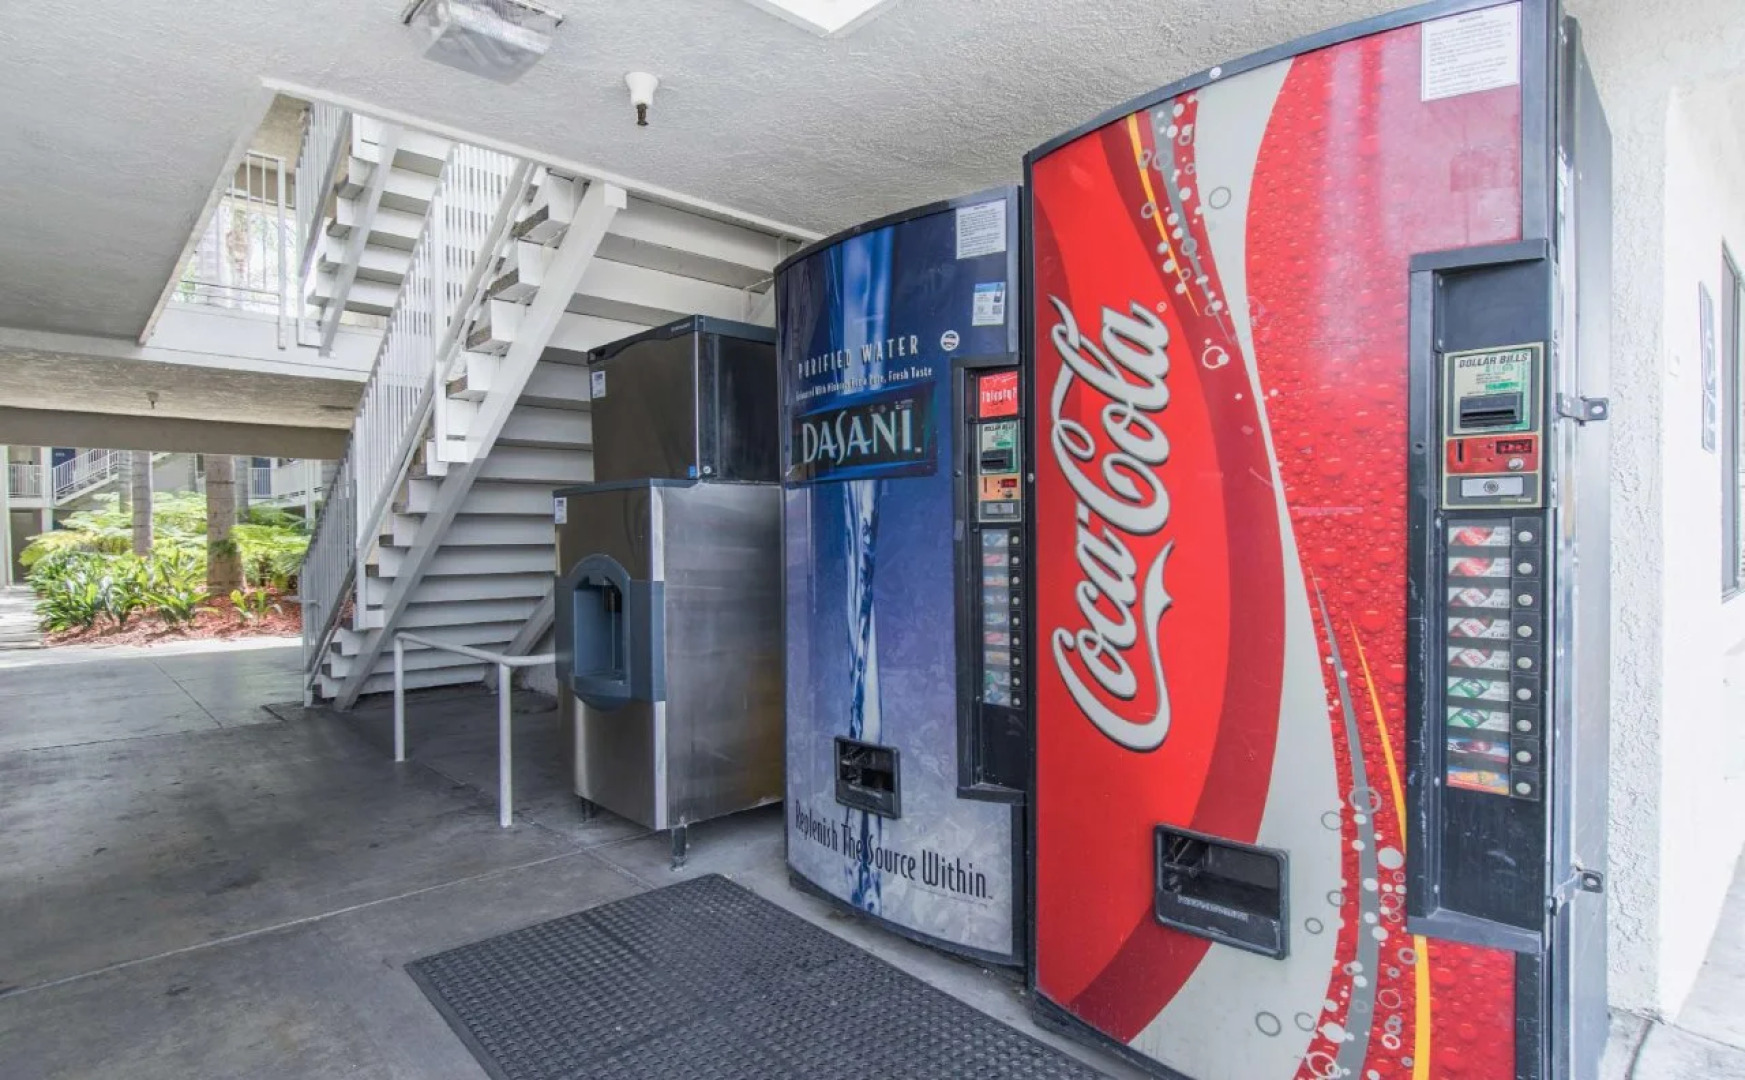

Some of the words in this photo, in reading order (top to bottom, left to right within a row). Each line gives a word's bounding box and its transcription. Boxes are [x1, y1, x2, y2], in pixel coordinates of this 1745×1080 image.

[798, 349, 851, 379] PURIFIED
[861, 335, 918, 365] WATER
[889, 367, 909, 381] Fresh
[911, 365, 932, 379] Taste
[1459, 356, 1498, 368] DOLLAR
[1500, 353, 1529, 365] BILLS
[802, 409, 912, 466] DASANI
[1047, 294, 1174, 754] Coca-Cola
[795, 799, 838, 852] Replenish
[841, 823, 863, 863] The
[867, 834, 916, 881] Source
